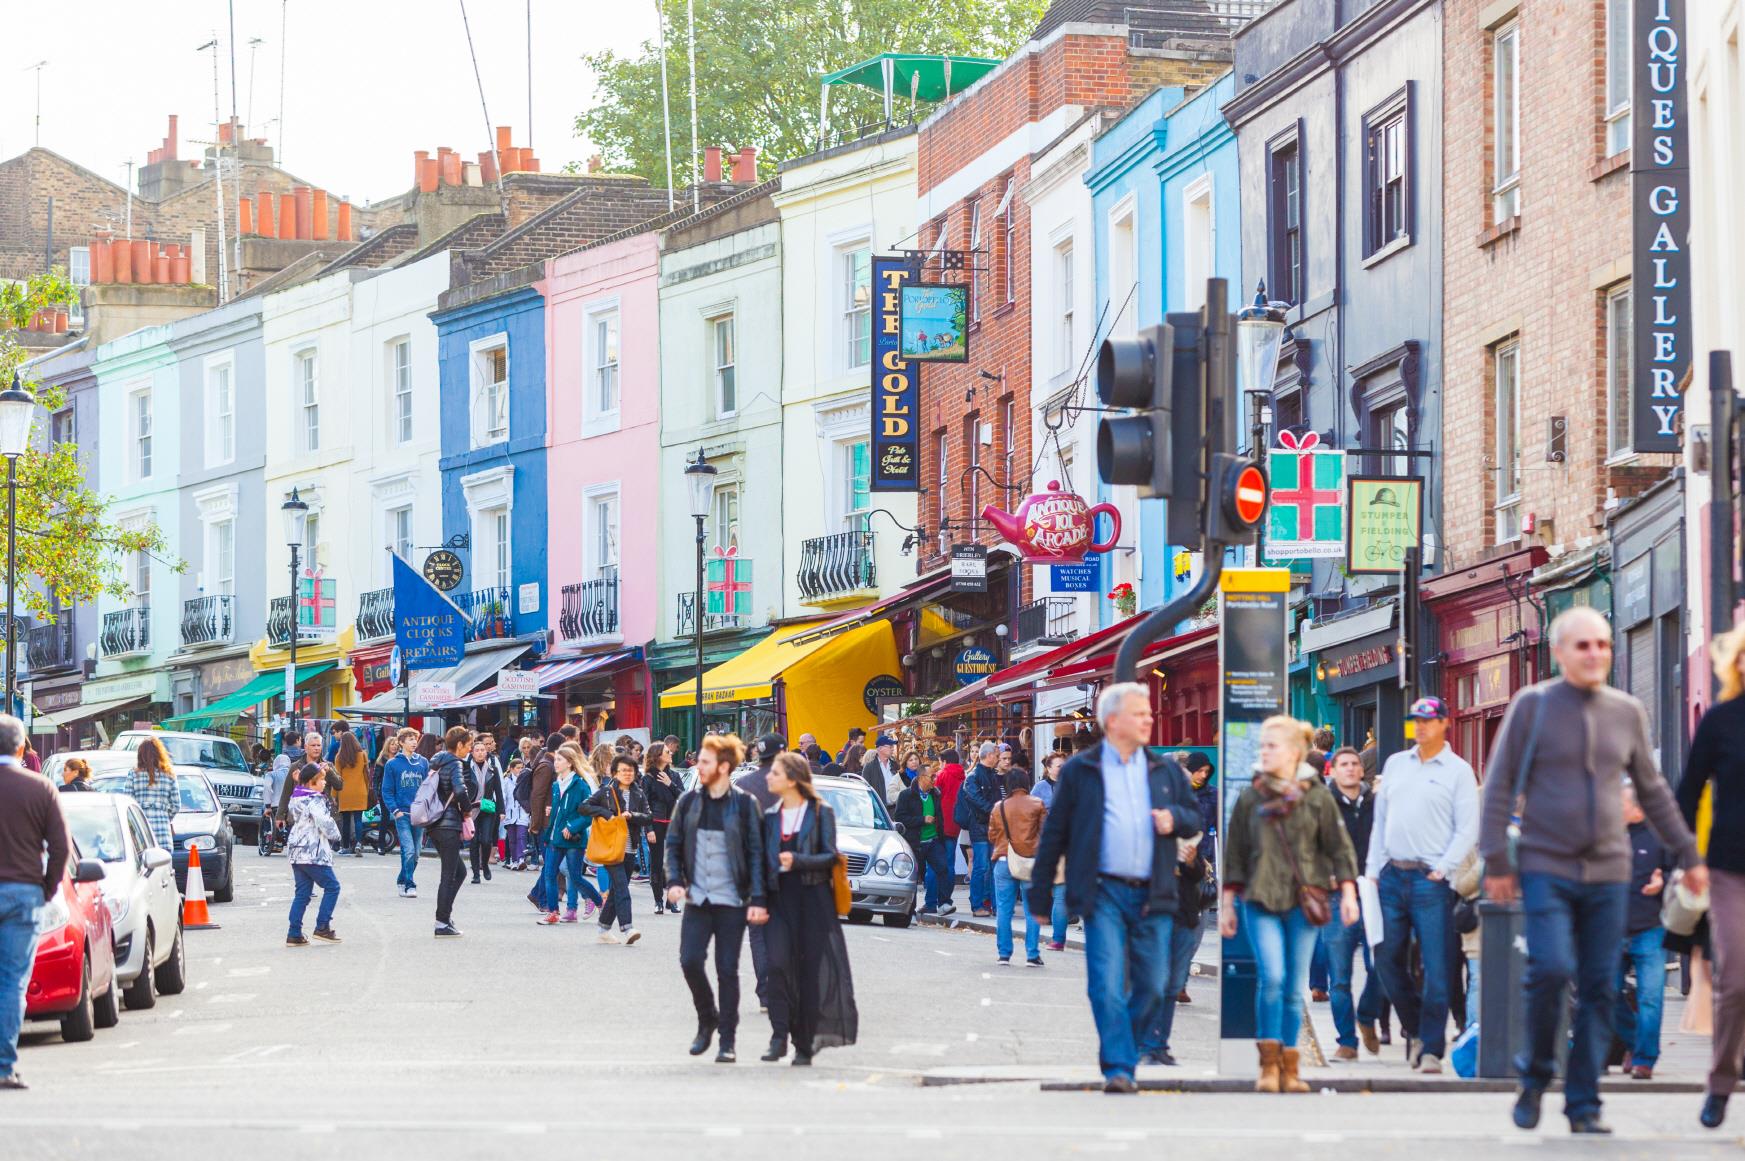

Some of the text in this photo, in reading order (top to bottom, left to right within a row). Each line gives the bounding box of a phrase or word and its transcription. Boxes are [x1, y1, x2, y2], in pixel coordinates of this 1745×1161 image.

[1649, 186, 1680, 436] GALLERY
[882, 351, 909, 436] GOLD
[888, 445, 906, 454] Pub
[901, 454, 911, 464] &
[1025, 499, 1087, 527] ANTIQUE
[1361, 511, 1408, 520] STUMPER
[1031, 523, 1088, 549] ARCADE
[1360, 527, 1409, 536] FIELDING
[1267, 547, 1342, 557] shopportobello.co.uk
[402, 615, 455, 627] ANTIQUE
[406, 626, 453, 639] CLOCKS
[424, 638, 435, 647] &
[405, 645, 458, 658] REPAIRS
[963, 649, 991, 664] Gallery
[956, 663, 997, 674] GUESTHOUSE
[502, 683, 536, 691] CASHMERE
[866, 687, 903, 697] OYSTER
